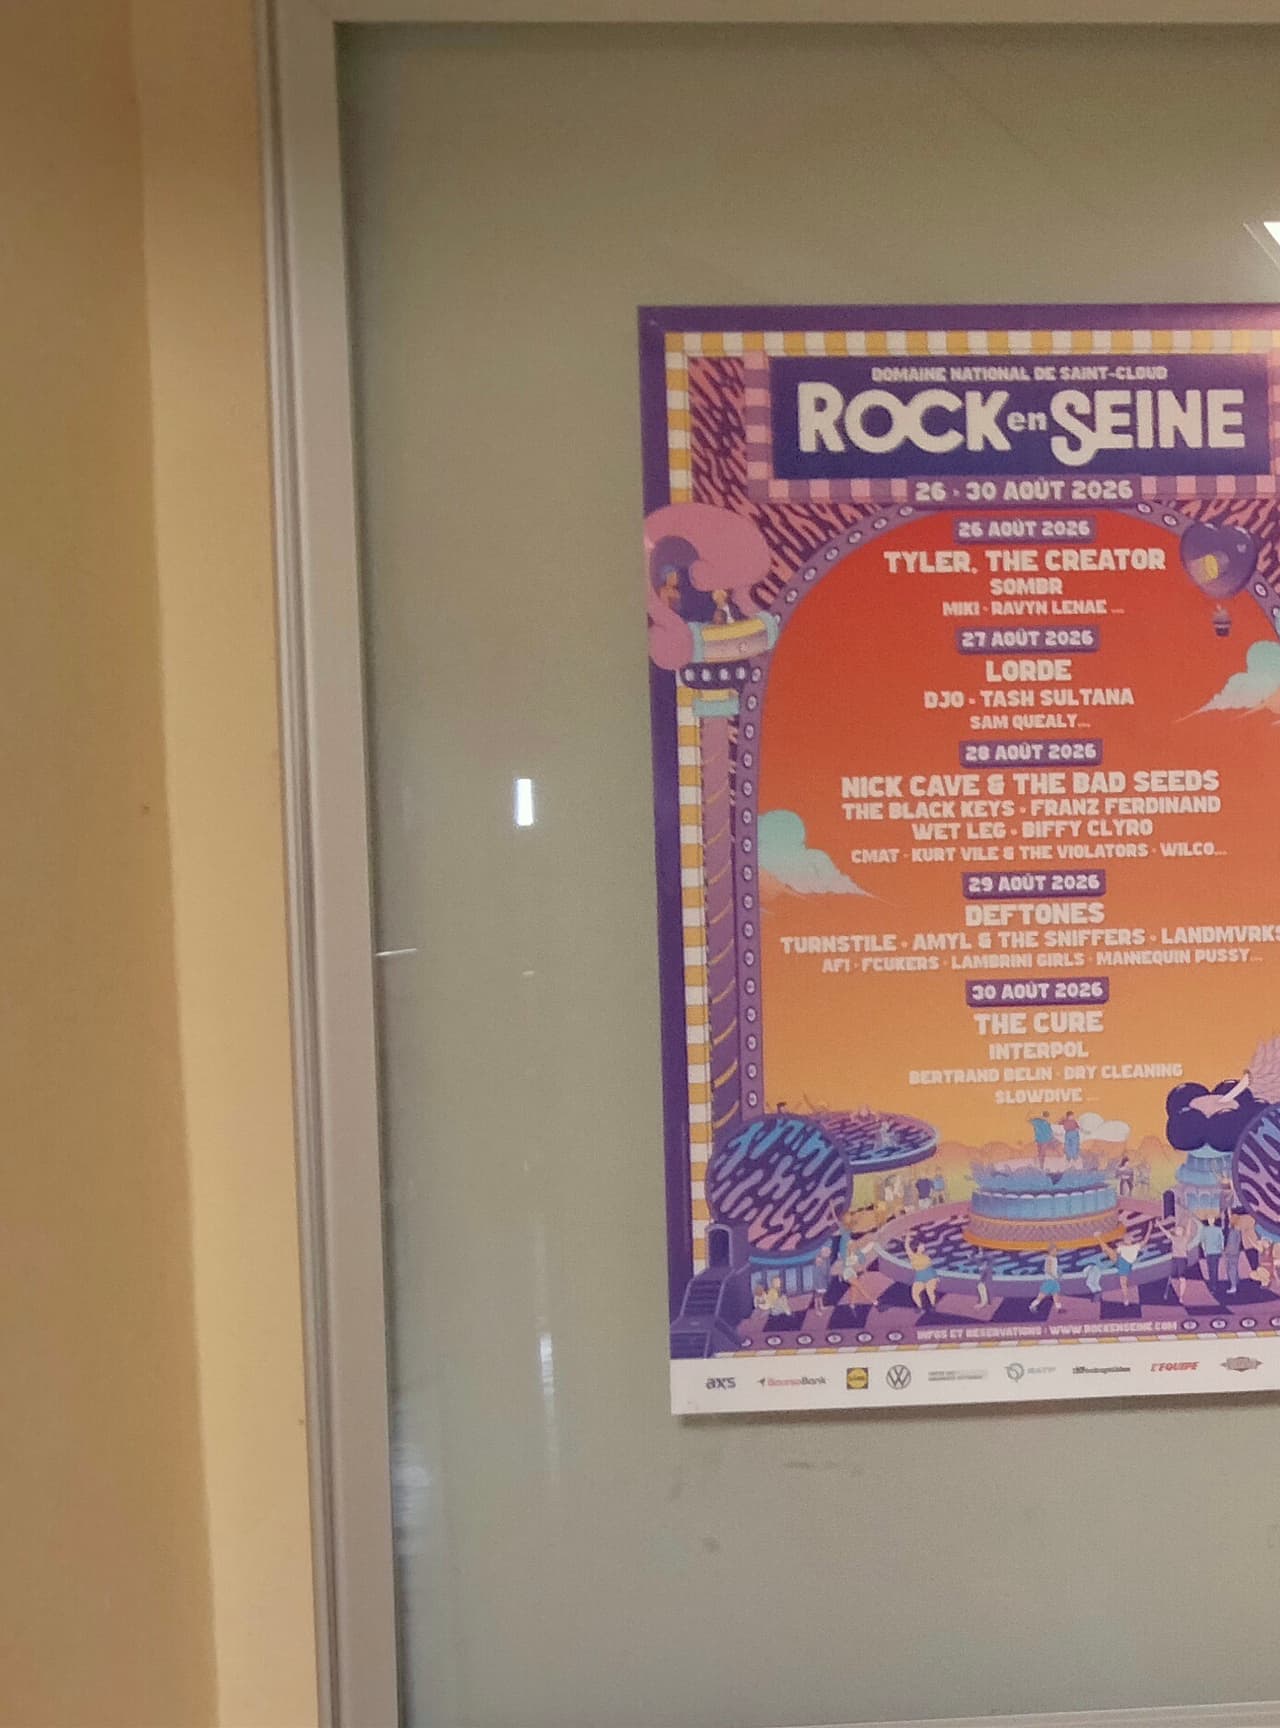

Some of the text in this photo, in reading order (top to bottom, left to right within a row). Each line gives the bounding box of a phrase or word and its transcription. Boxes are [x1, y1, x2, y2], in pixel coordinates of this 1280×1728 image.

[872, 366, 1168, 382] DOMAINE NATIONAL DE SAINT-CLOUD
[797, 381, 1245, 467] ROCK en SEINE
[915, 482, 946, 501] 26
[966, 481, 996, 501] 30
[1003, 477, 1065, 500] AOÛT
[1071, 480, 1133, 500] 2026
[958, 519, 1090, 537] 26 AOÛT 2026
[985, 551, 1038, 571] THE
[1045, 548, 1166, 571] CREATOR
[990, 577, 1063, 595] SOMBR
[942, 602, 980, 616] MIKI
[991, 601, 1048, 615] RAVYN
[1051, 600, 1107, 614] LENAE
[961, 628, 1094, 648] 27 AOÛT 2026
[985, 659, 1073, 682] LORDE
[924, 690, 965, 708] DJO
[980, 690, 1035, 707] TASH
[1040, 688, 1135, 706] SULTANA
[970, 715, 1008, 729] SAM
[965, 743, 1097, 761] 28 AOÛT 2026
[841, 770, 1220, 798] NICK CAVE & THE BAD SEEDS
[841, 803, 884, 820] THE
[888, 801, 956, 819] BLACK
[960, 801, 1015, 818] KEYS
[1030, 798, 1100, 817] FRANZ
[1104, 796, 1222, 815] FERDINAND
[912, 822, 961, 840] WET
[966, 822, 1006, 839] LEG
[1022, 821, 1082, 838] BIFFY
[1086, 819, 1154, 837] CLYRO
[851, 849, 900, 864] CMAT
[911, 847, 956, 863] KURT
[960, 846, 999, 862] VILE
[1003, 846, 1015, 860] &
[1019, 845, 1053, 860] THE
[1056, 844, 1149, 859] VIOLATORS
[968, 874, 1100, 893] 29 AOÛT 2026
[964, 902, 1105, 926] DEFTONES
[780, 934, 897, 954] TURNSTILE
[912, 932, 972, 951] AMYL
[977, 933, 992, 949] &
[998, 931, 1039, 949] THE
[1044, 928, 1146, 948] SNIFFERS
[821, 958, 850, 974] AFI
[862, 956, 940, 973] FCUKERS
[951, 954, 1033, 970] LAMBRINI
[1037, 952, 1085, 967] GIRLS
[1096, 950, 1191, 966] MANNEQUIN
[972, 982, 1103, 1000] 30 AOÛT 2026
[974, 1010, 1104, 1035] THE CURE
[989, 1041, 1089, 1061] INTERPOL
[908, 1068, 1000, 1085] BERTRAND
[1004, 1067, 1053, 1082] BELIN
[1064, 1065, 1096, 1080] DRY
[1101, 1063, 1183, 1079] CLEANING
[995, 1088, 1082, 1104] SLOWDIVE
